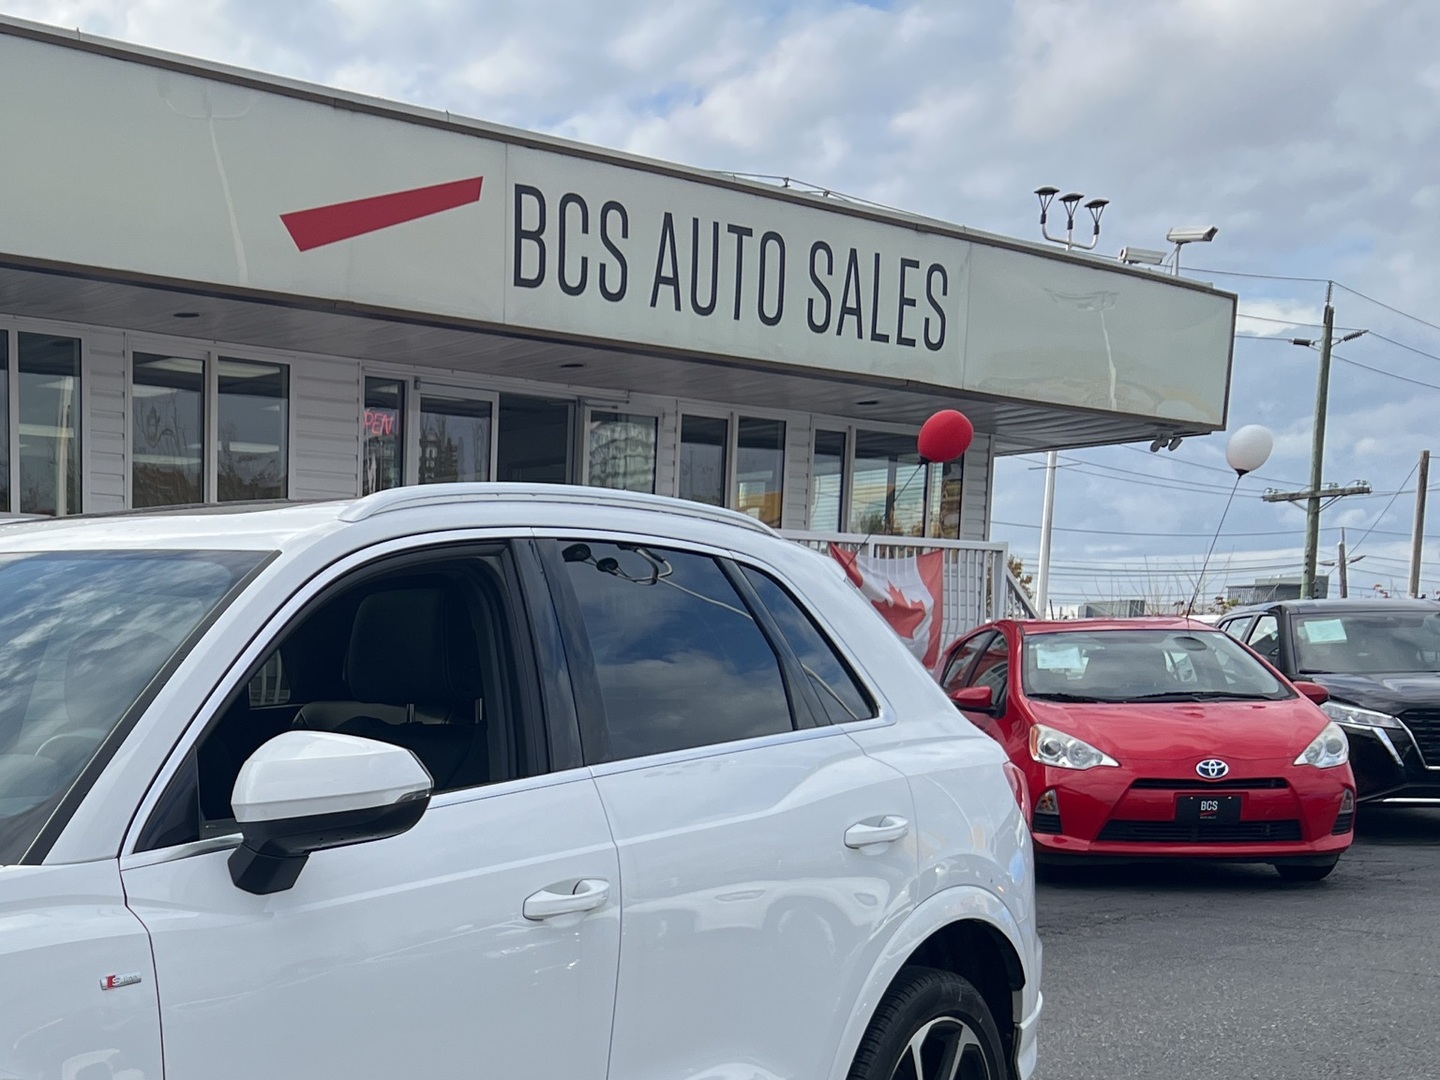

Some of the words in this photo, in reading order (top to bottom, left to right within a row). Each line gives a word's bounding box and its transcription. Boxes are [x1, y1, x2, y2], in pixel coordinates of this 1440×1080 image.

[513, 183, 629, 303] BCS
[649, 211, 786, 326] AUTO
[806, 240, 948, 352] SALES
[364, 410, 395, 435] PEN
[1200, 800, 1218, 811] BCS
